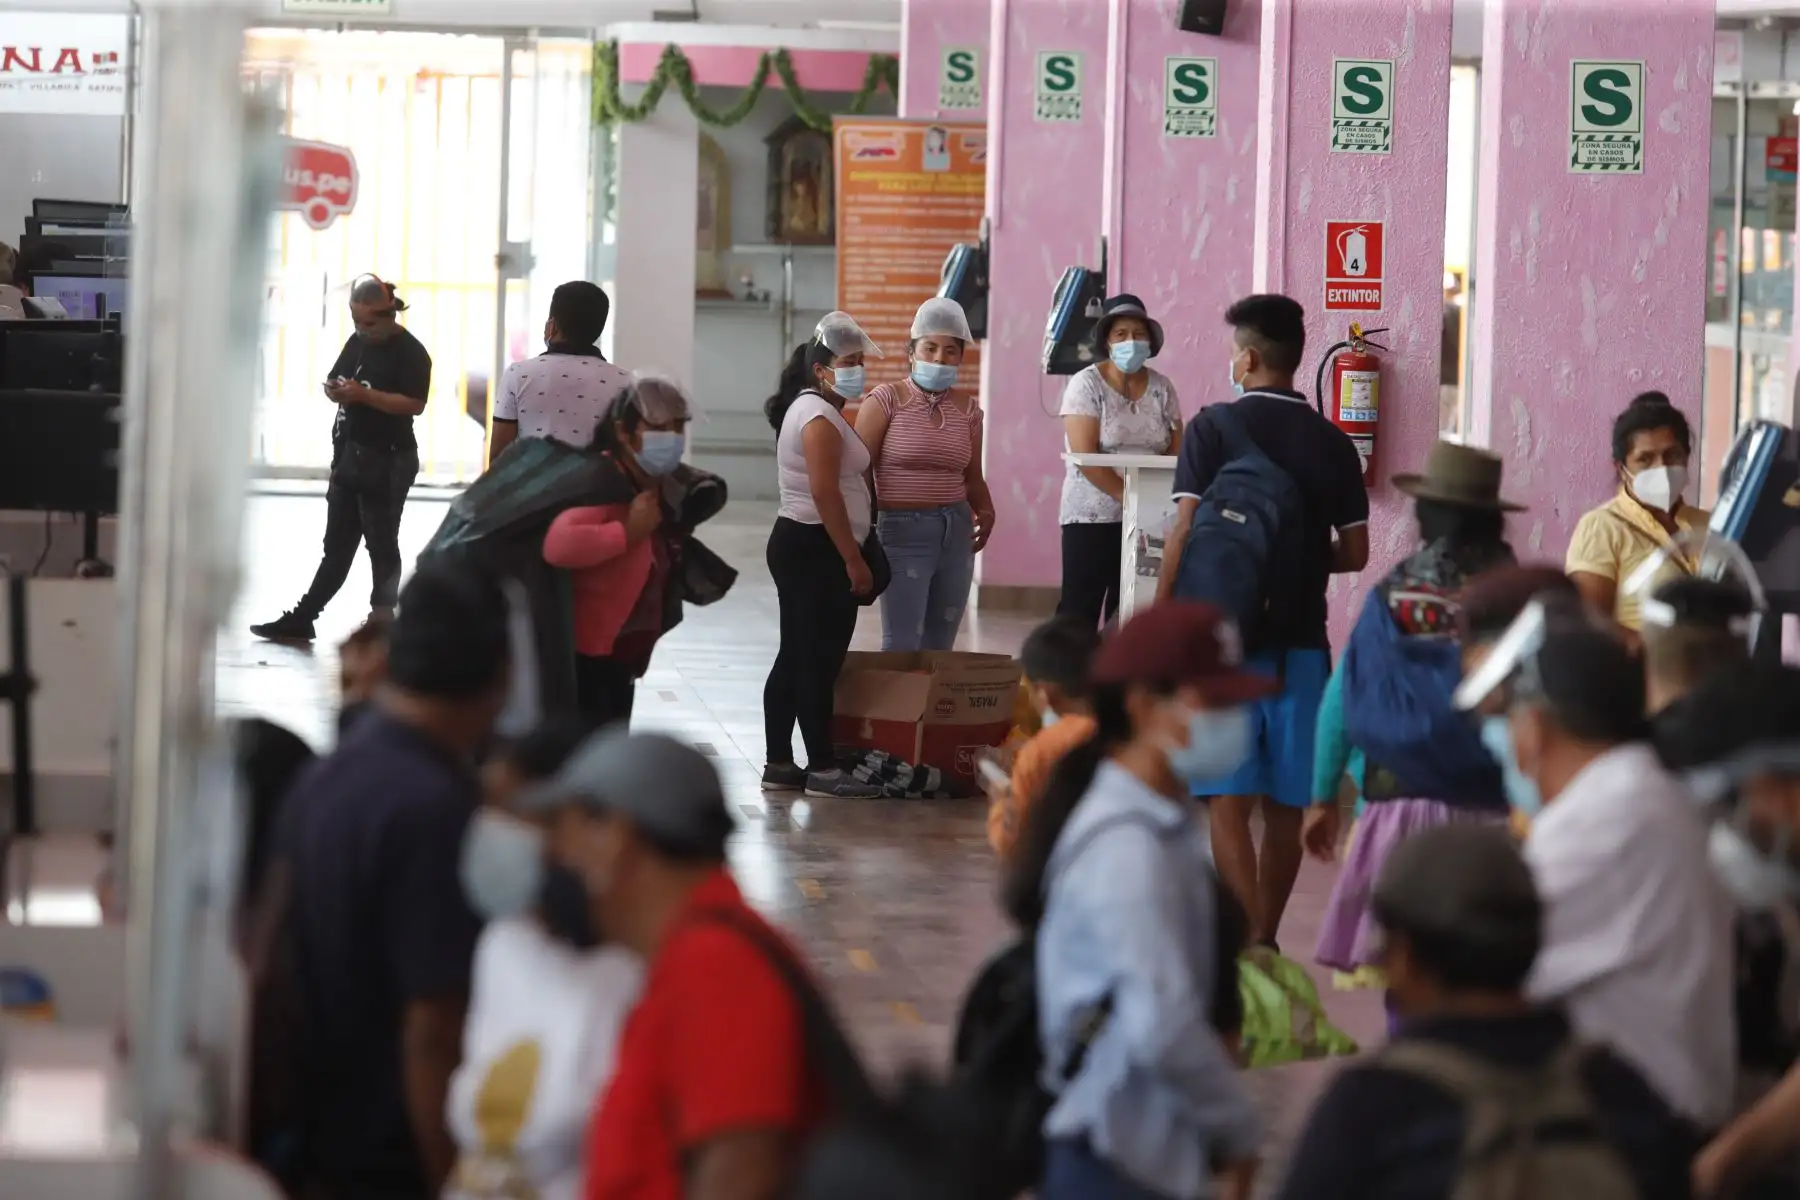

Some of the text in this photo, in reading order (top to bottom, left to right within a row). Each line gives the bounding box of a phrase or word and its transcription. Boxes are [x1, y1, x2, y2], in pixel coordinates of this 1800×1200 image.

[947, 52, 974, 83] S
[1044, 56, 1076, 92] S
[1173, 63, 1209, 104] S
[1341, 66, 1384, 114] S
[1581, 68, 1633, 126] S
[1350, 258, 1359, 271] 4
[1328, 288, 1380, 303] EXTINTOR
